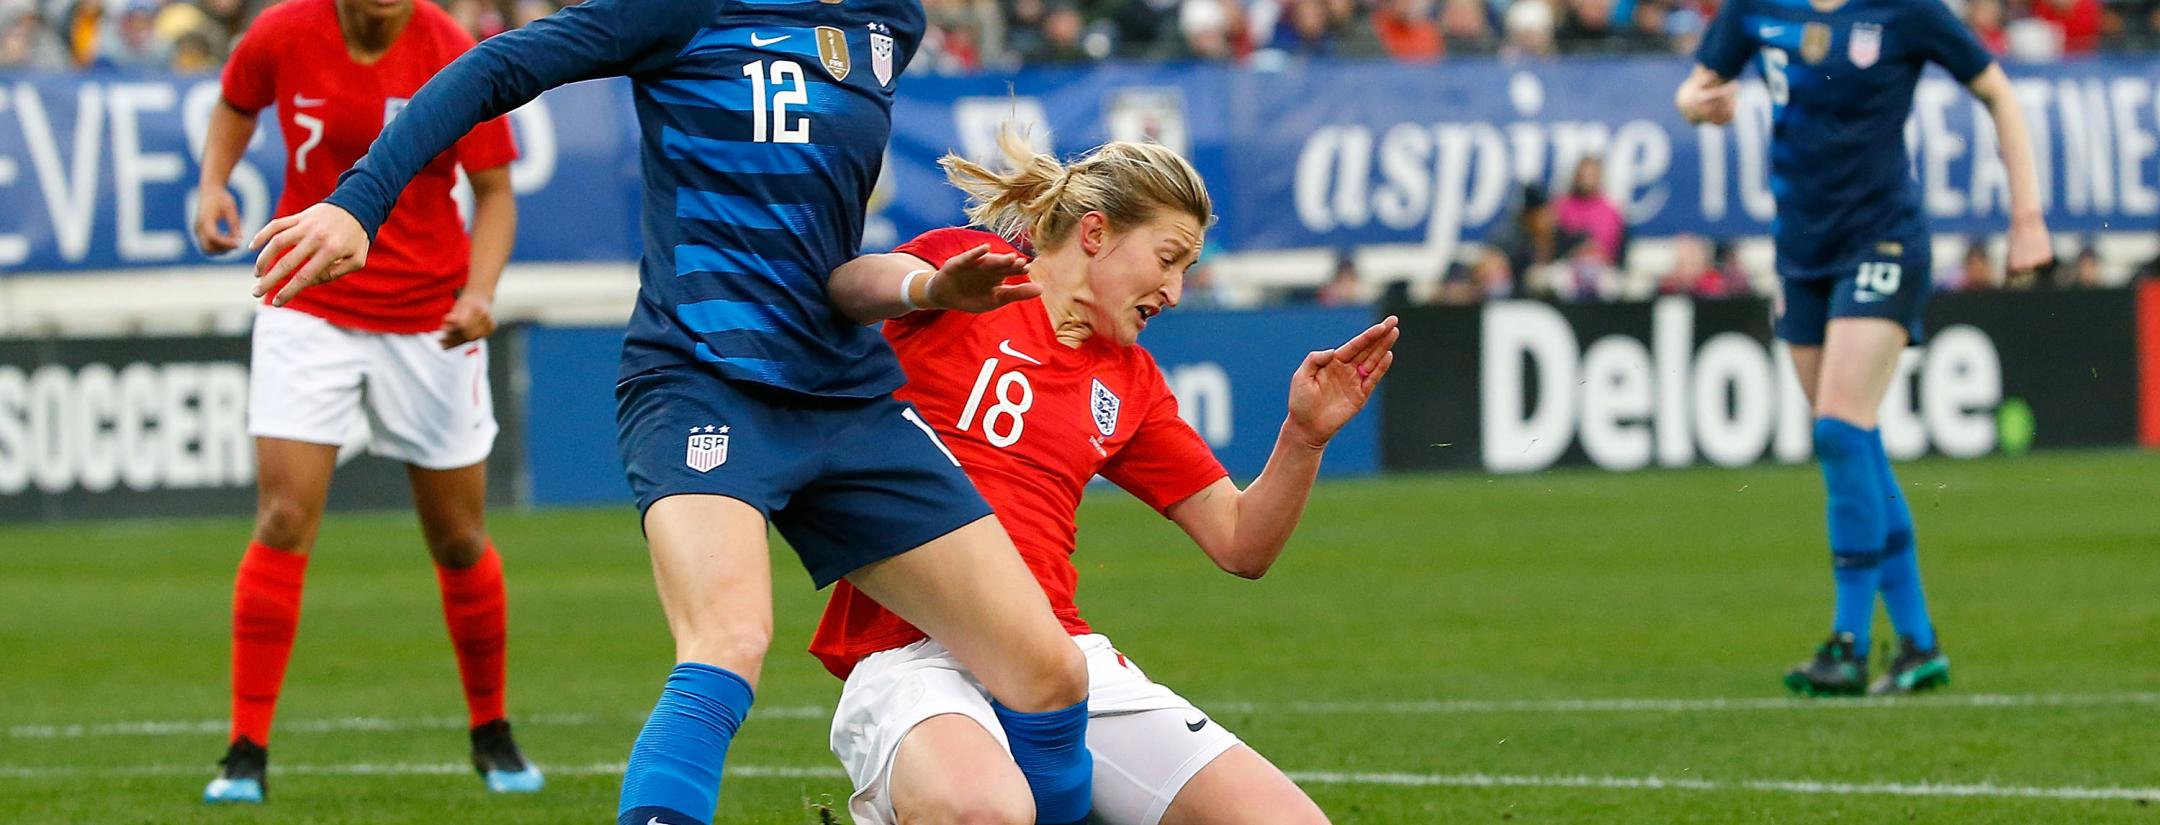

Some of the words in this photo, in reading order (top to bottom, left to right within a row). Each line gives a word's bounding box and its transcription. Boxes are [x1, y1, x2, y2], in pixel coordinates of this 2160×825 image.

[294, 113, 324, 173] 7
[743, 60, 809, 143] 12
[1294, 71, 1672, 283] aspire
[0, 362, 254, 493] SOCCER
[691, 436, 725, 451] USA
[956, 357, 1034, 447] 18
